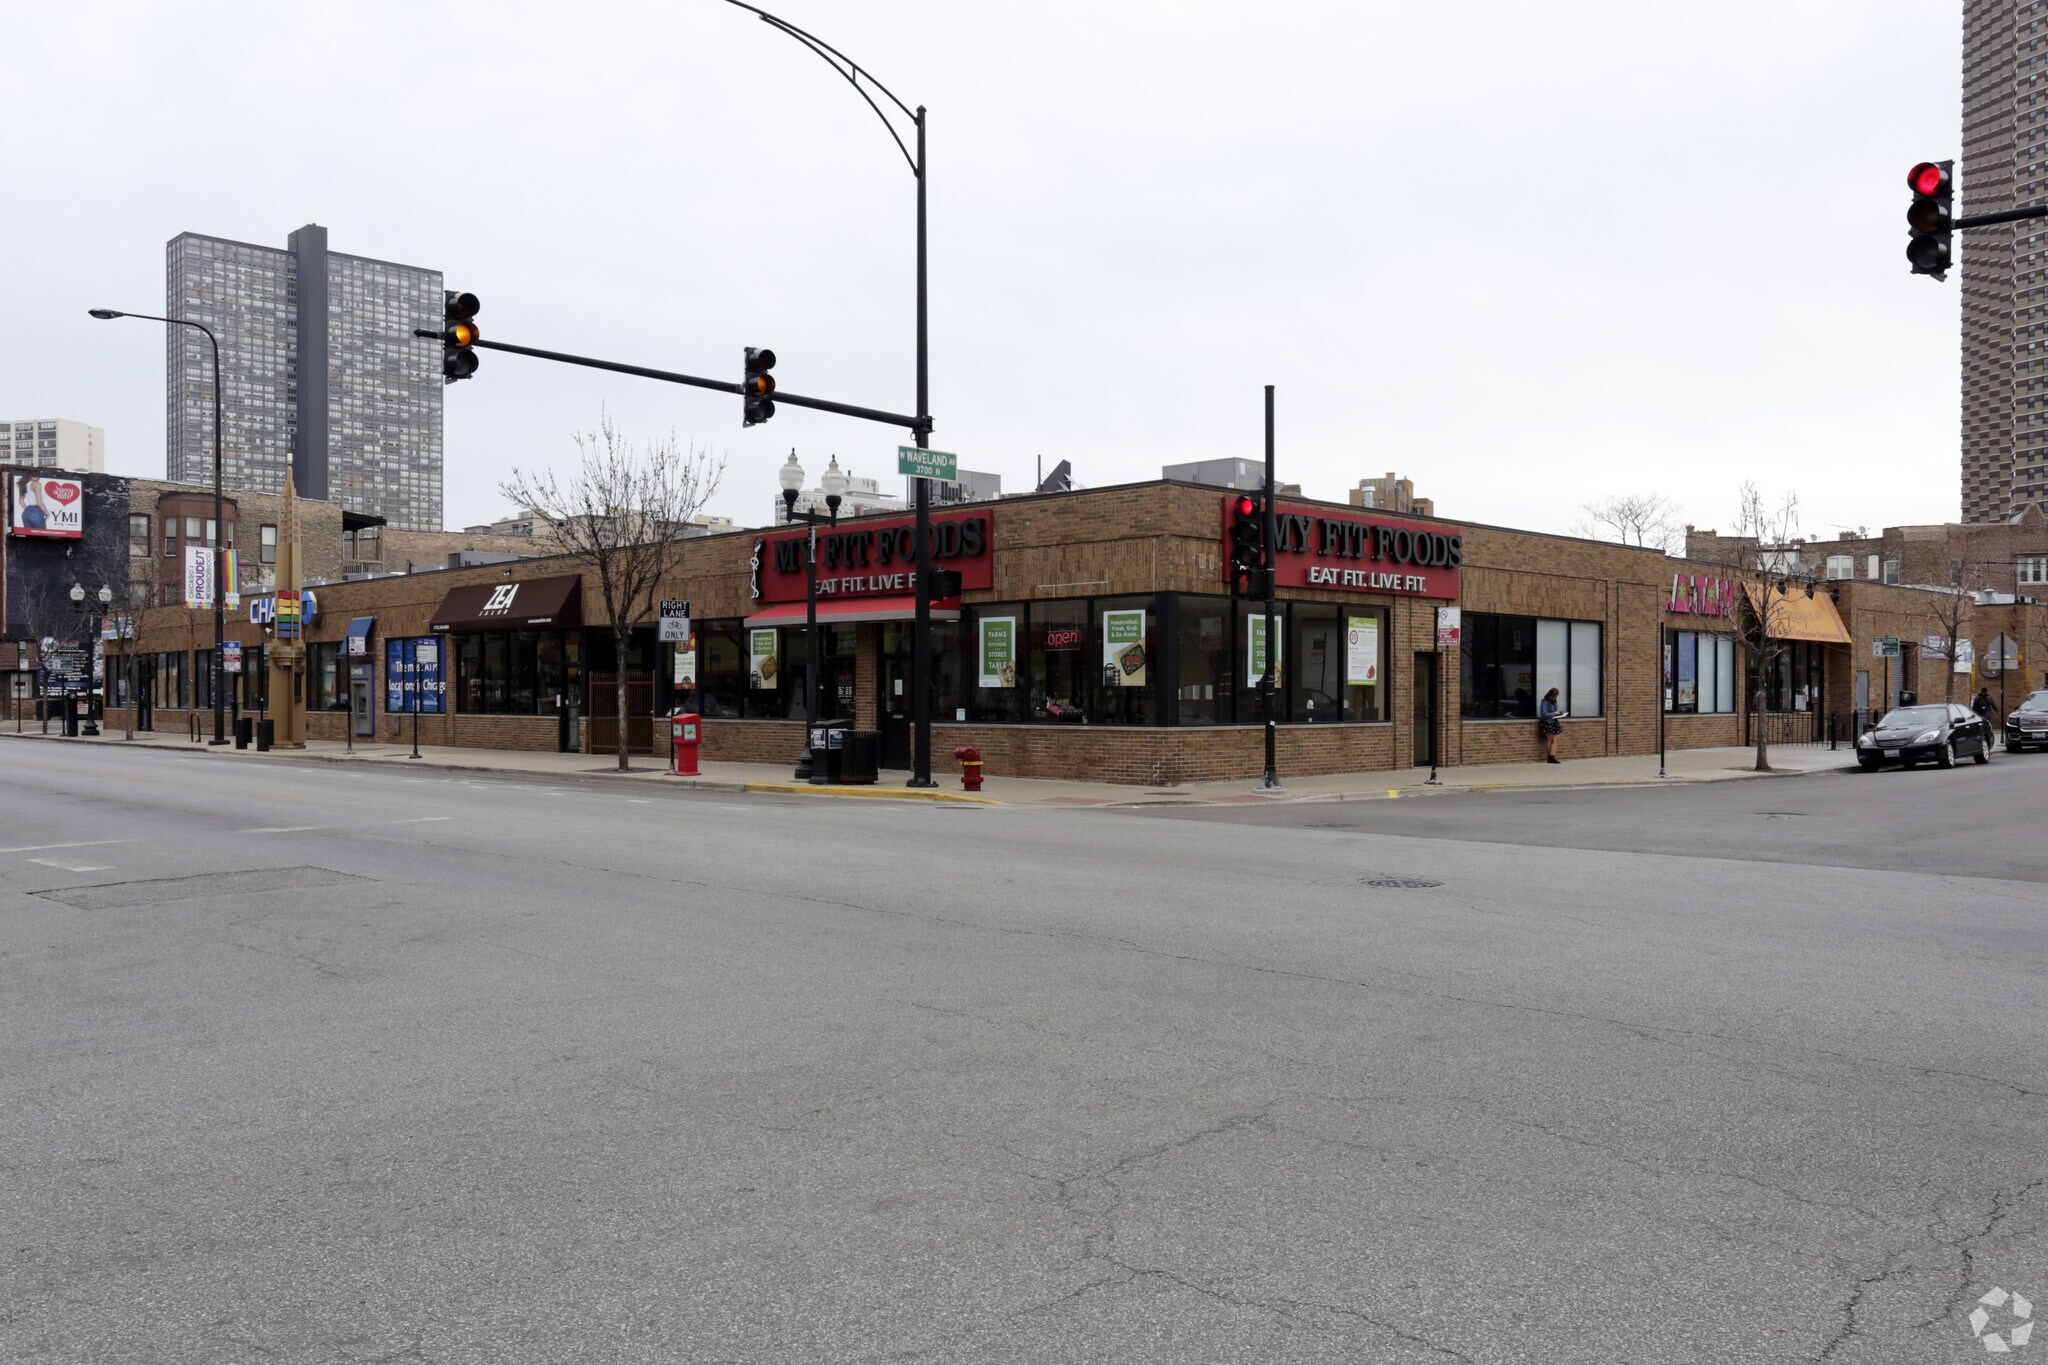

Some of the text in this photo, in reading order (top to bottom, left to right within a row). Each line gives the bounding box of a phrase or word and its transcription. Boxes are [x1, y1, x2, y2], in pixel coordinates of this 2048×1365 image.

[899, 450, 956, 467] W WAVELAND AV
[915, 464, 941, 476] 3700 N
[50, 509, 78, 523] YMI
[822, 530, 873, 568] FIT
[1273, 513, 1463, 568] MY FIT FOODS
[195, 550, 205, 600] PROUDEST
[1310, 566, 1427, 592] EAT FIT. LIVE FIT.
[815, 578, 838, 595] EAT
[841, 576, 865, 593] FIT.
[869, 573, 904, 591] LIVE
[482, 583, 520, 610] ZEA
[662, 600, 687, 610] RIGHT
[249, 597, 276, 624] CHA
[663, 609, 686, 618] LANE
[665, 631, 684, 639] ONLY
[1048, 630, 1078, 647] open
[422, 678, 446, 695] Chicago
